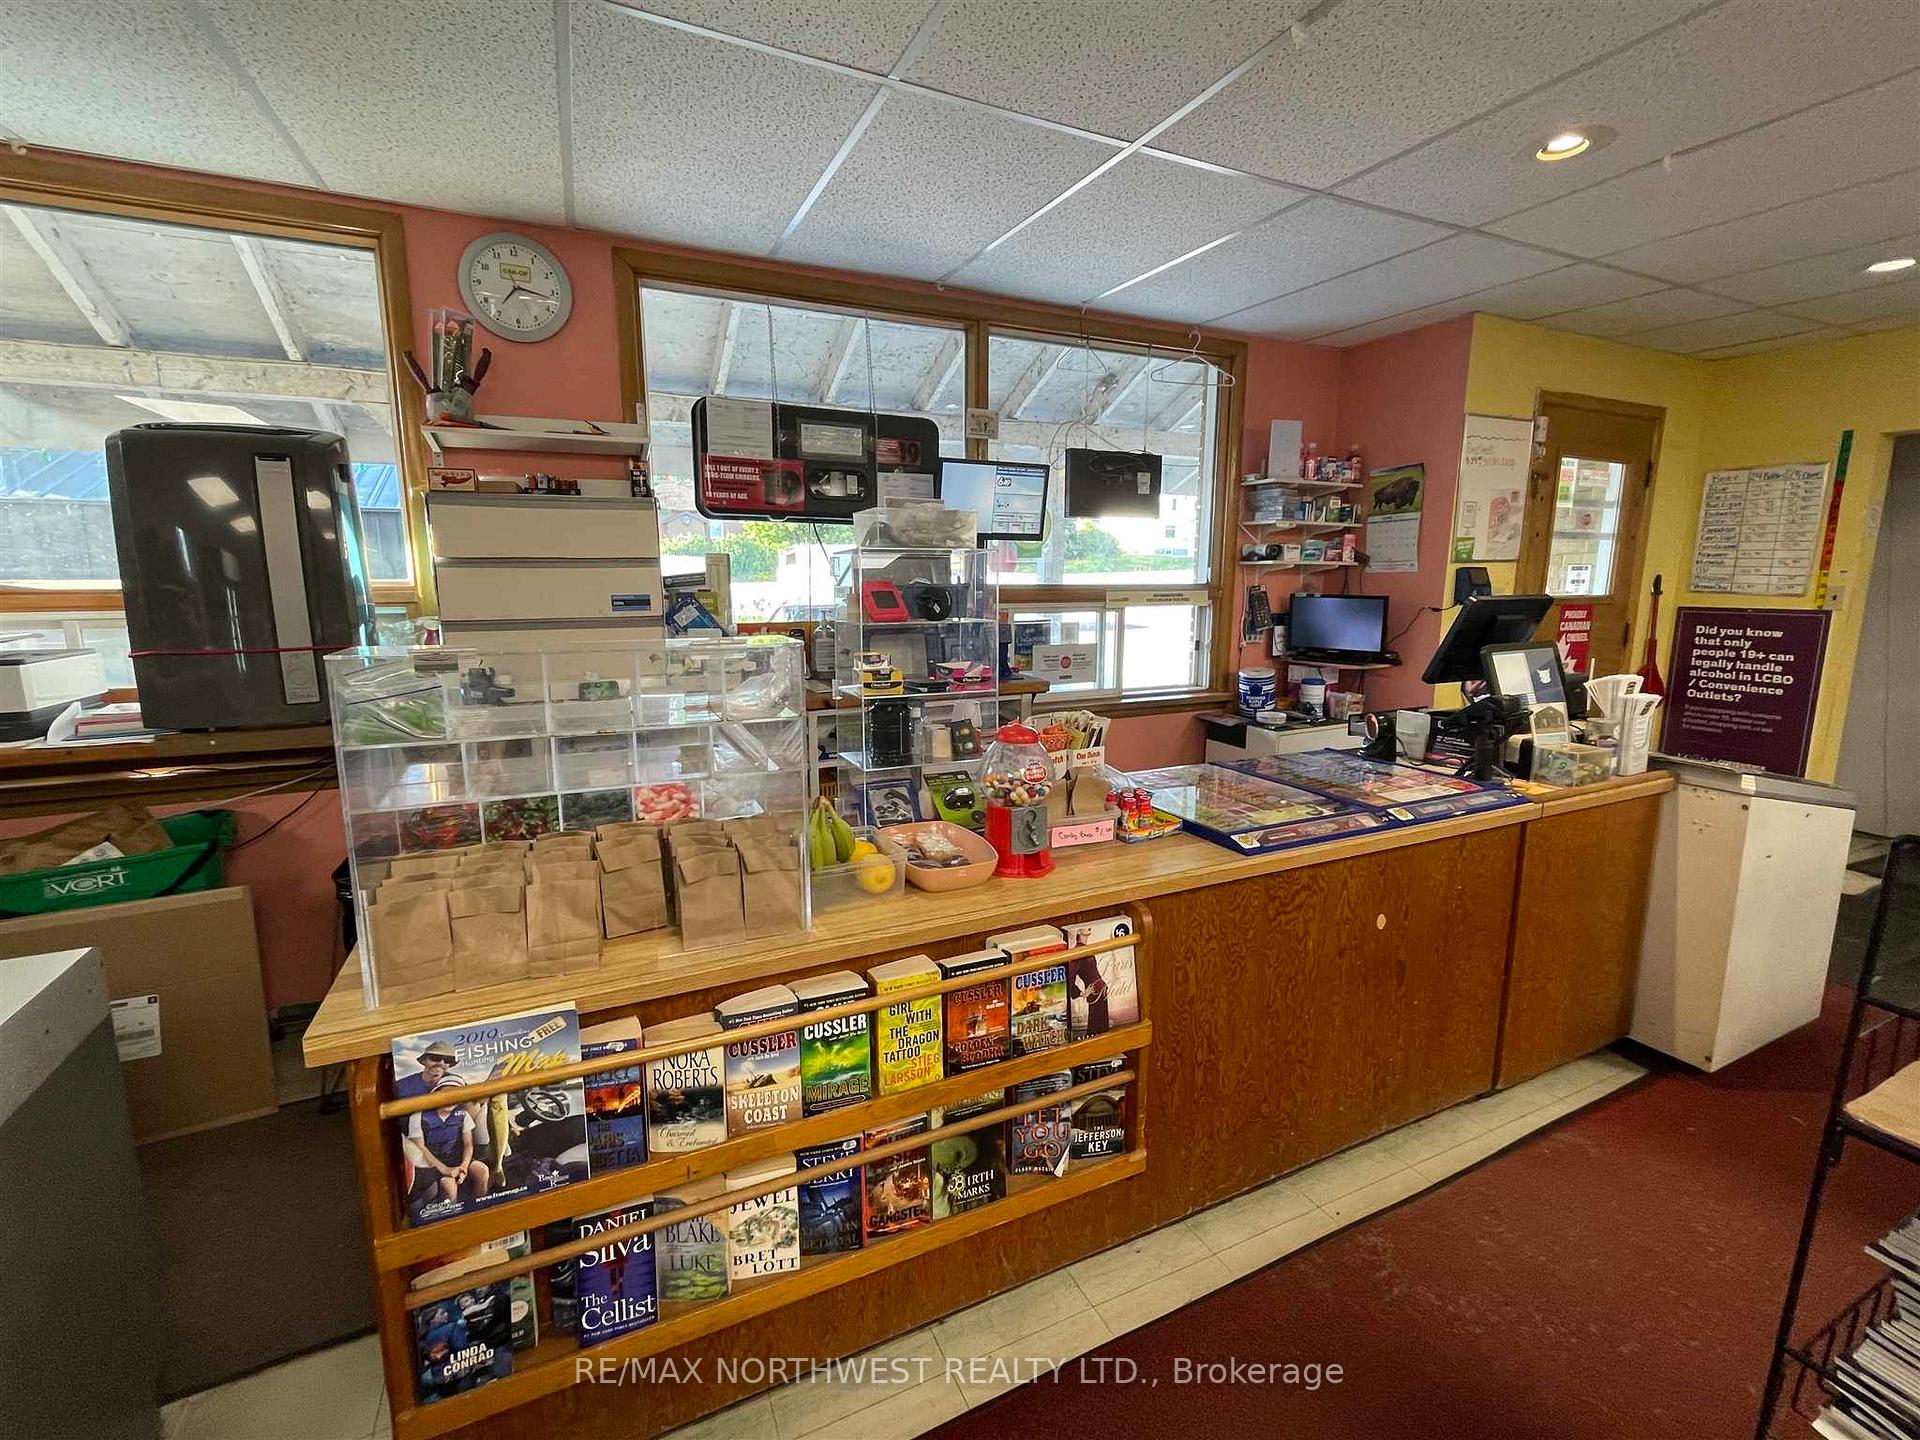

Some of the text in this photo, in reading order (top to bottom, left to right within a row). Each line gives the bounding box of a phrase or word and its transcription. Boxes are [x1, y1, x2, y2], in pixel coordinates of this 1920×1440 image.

[1695, 625, 1784, 638] Did you know
[1694, 636, 1753, 649] that only
[1692, 648, 1795, 662] people 19+ can
[1691, 657, 1783, 673] legally handle
[1689, 669, 1794, 685] alcohol in LCBO
[1686, 688, 1742, 702] Outlets?
[1688, 678, 1784, 696] / Convenience
[1015, 966, 1066, 991] CUSSLER
[952, 983, 1003, 1005] CUSSLER
[889, 1001, 913, 1017] GIRL
[906, 1008, 932, 1025] WITH
[537, 1019, 562, 1038] FREE
[804, 1013, 867, 1041] CUSSLER
[890, 1025, 909, 1040] THE
[1016, 1017, 1048, 1036] DARK
[454, 1036, 533, 1062] FISHING
[728, 1031, 797, 1058] CUSSLER
[898, 1029, 940, 1050] DRAGON
[953, 1036, 994, 1053] GOLDEN
[662, 1049, 711, 1071] NORA
[883, 1045, 921, 1064] TATTOO
[911, 1052, 940, 1069] STIEG
[653, 1066, 718, 1091] ROBERTS
[884, 1066, 931, 1086] LARSSON
[731, 1085, 799, 1110] SKELETON
[805, 1076, 869, 1103] MIRAGE
[743, 1104, 788, 1125] COAST
[1024, 1107, 1064, 1127] LET
[1015, 1123, 1071, 1145] YOU
[1074, 1128, 1122, 1143] JEFFERSON
[1024, 1141, 1061, 1159] GO
[1088, 1140, 1108, 1153] KEY
[948, 1169, 994, 1193] BIRTH
[957, 1183, 990, 1200] MARKS
[730, 1189, 796, 1215] JEWEL
[579, 1208, 647, 1240] DANIEL
[665, 1221, 720, 1244] BLAKE
[670, 1254, 716, 1274] LUKE
[733, 1248, 779, 1267] BRET
[753, 1257, 797, 1275] LOTT
[581, 1293, 608, 1309] The
[581, 1294, 657, 1331] Cellist
[443, 1348, 495, 1378] CONRAD
[450, 1342, 488, 1365] LINDA
